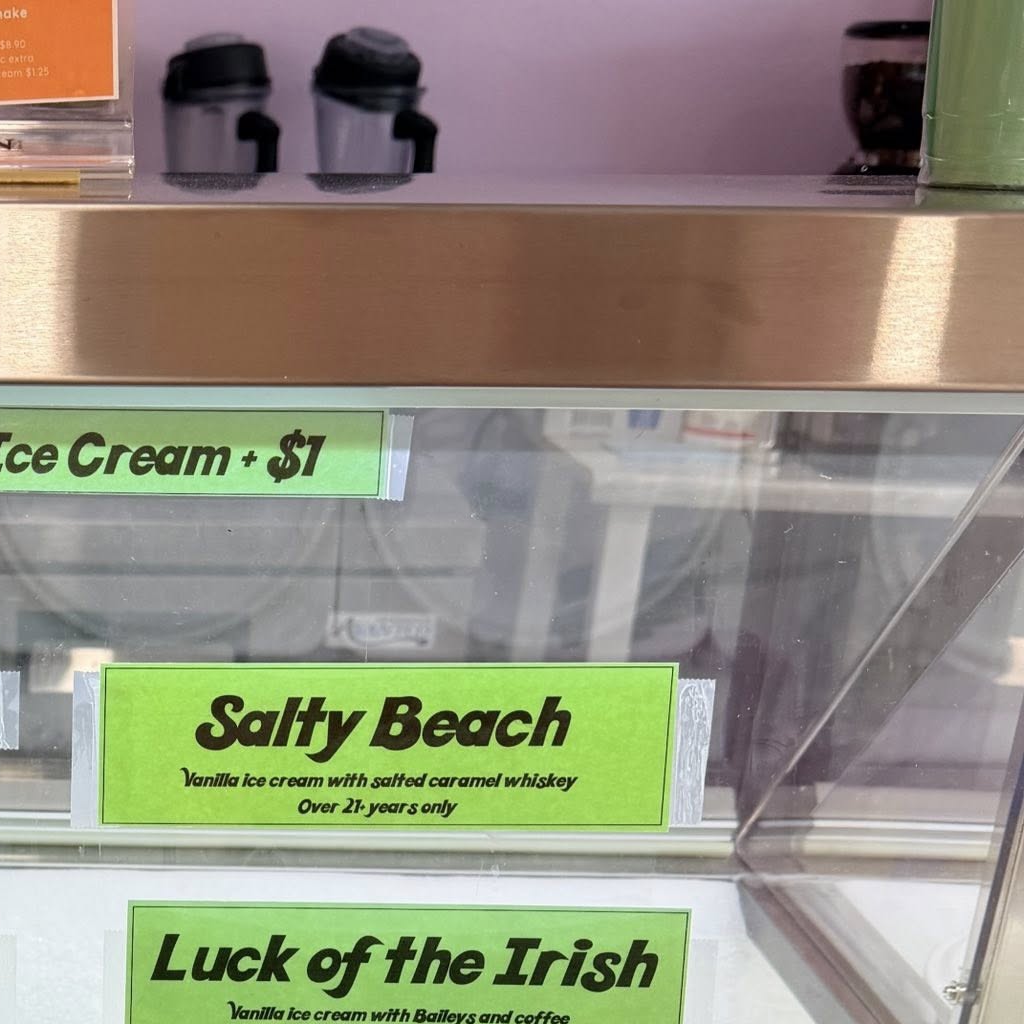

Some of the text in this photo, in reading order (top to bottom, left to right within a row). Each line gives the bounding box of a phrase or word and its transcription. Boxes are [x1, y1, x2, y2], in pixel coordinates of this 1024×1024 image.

[8, 54, 34, 63] extra
[68, 432, 231, 477] Cream
[267, 429, 327, 483] $1
[195, 695, 571, 763] Salty Beach
[180, 768, 578, 792] Vanilla ice cream with salted caramel whiskey
[298, 798, 458, 818] Over 21+ years only
[150, 934, 658, 998] Luck of the Irish
[228, 1001, 285, 1020] Vanilla
[287, 1007, 311, 1020] ice
[314, 1011, 367, 1021] cream
[371, 1009, 410, 1022] with
[479, 1011, 513, 1024] and
